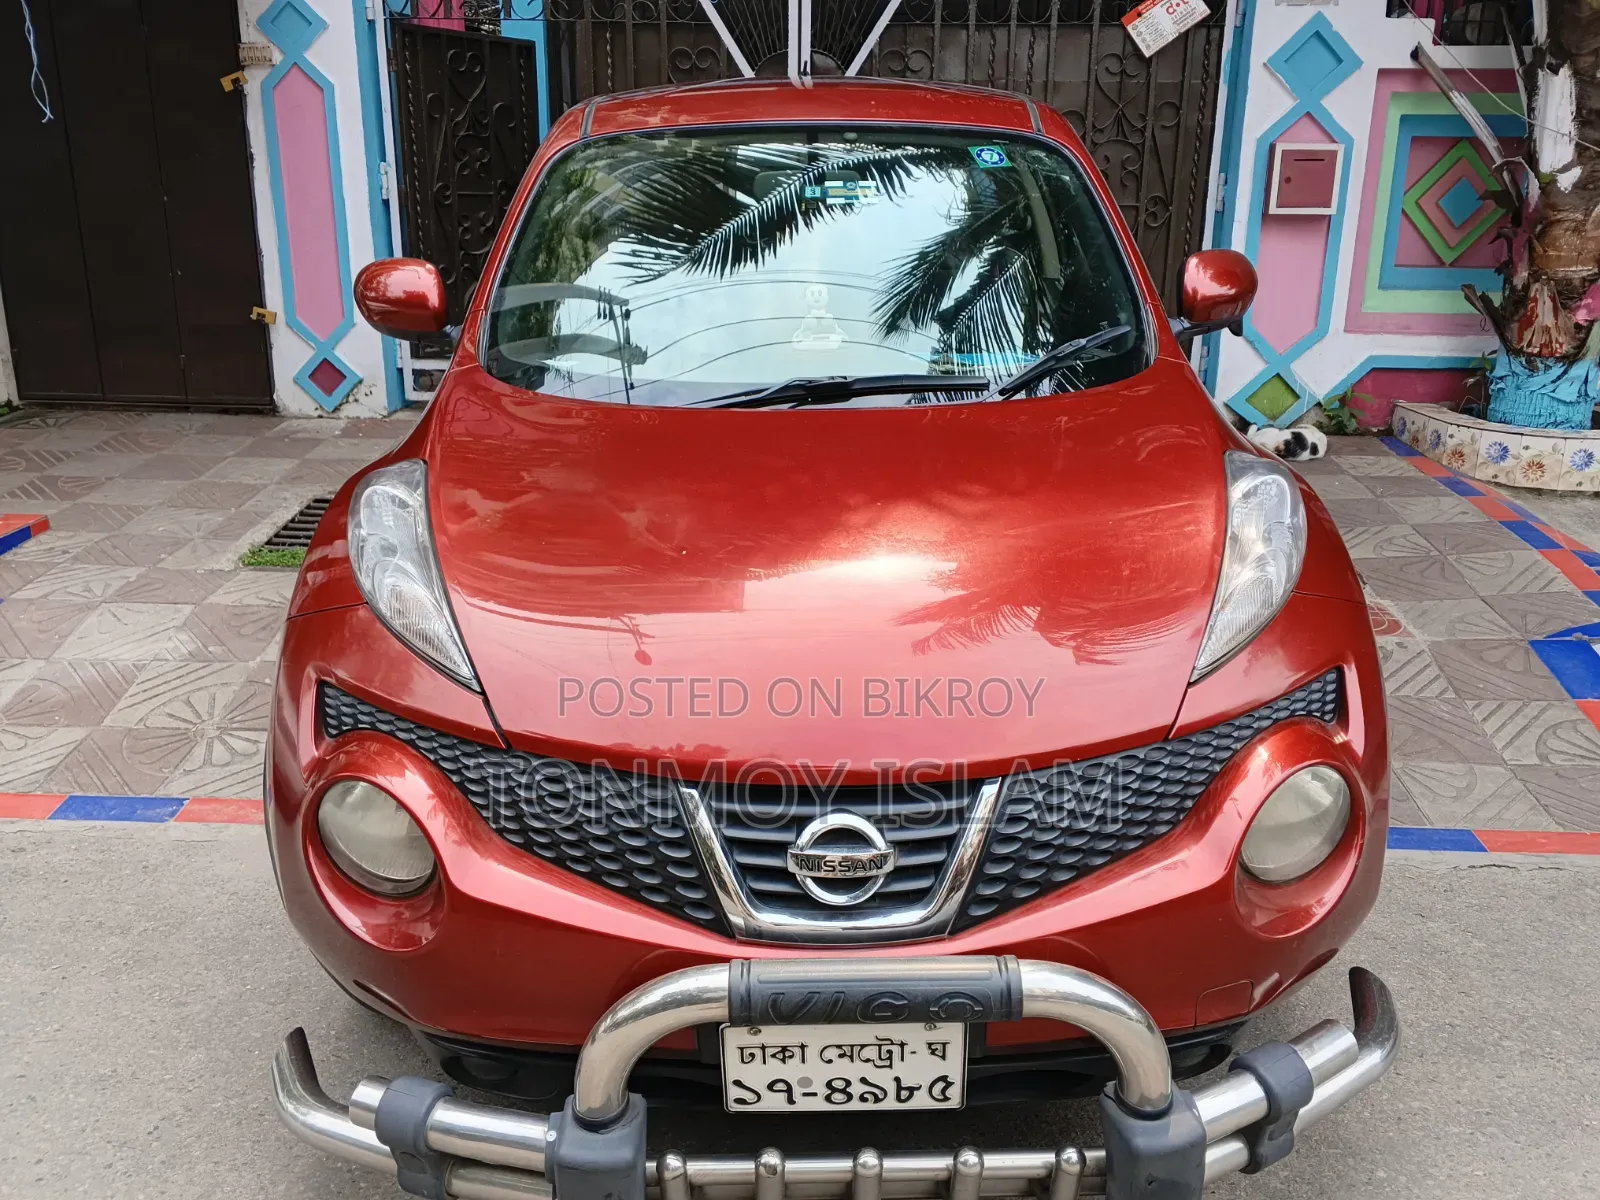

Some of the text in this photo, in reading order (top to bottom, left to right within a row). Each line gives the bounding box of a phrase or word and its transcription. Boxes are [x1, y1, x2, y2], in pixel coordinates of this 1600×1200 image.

[799, 859, 883, 872] NISSAN
[769, 991, 983, 1023] VIGO
[737, 1042, 808, 1064] ঢাকা
[731, 1074, 955, 1105] ১৭-৪৯৮৫
